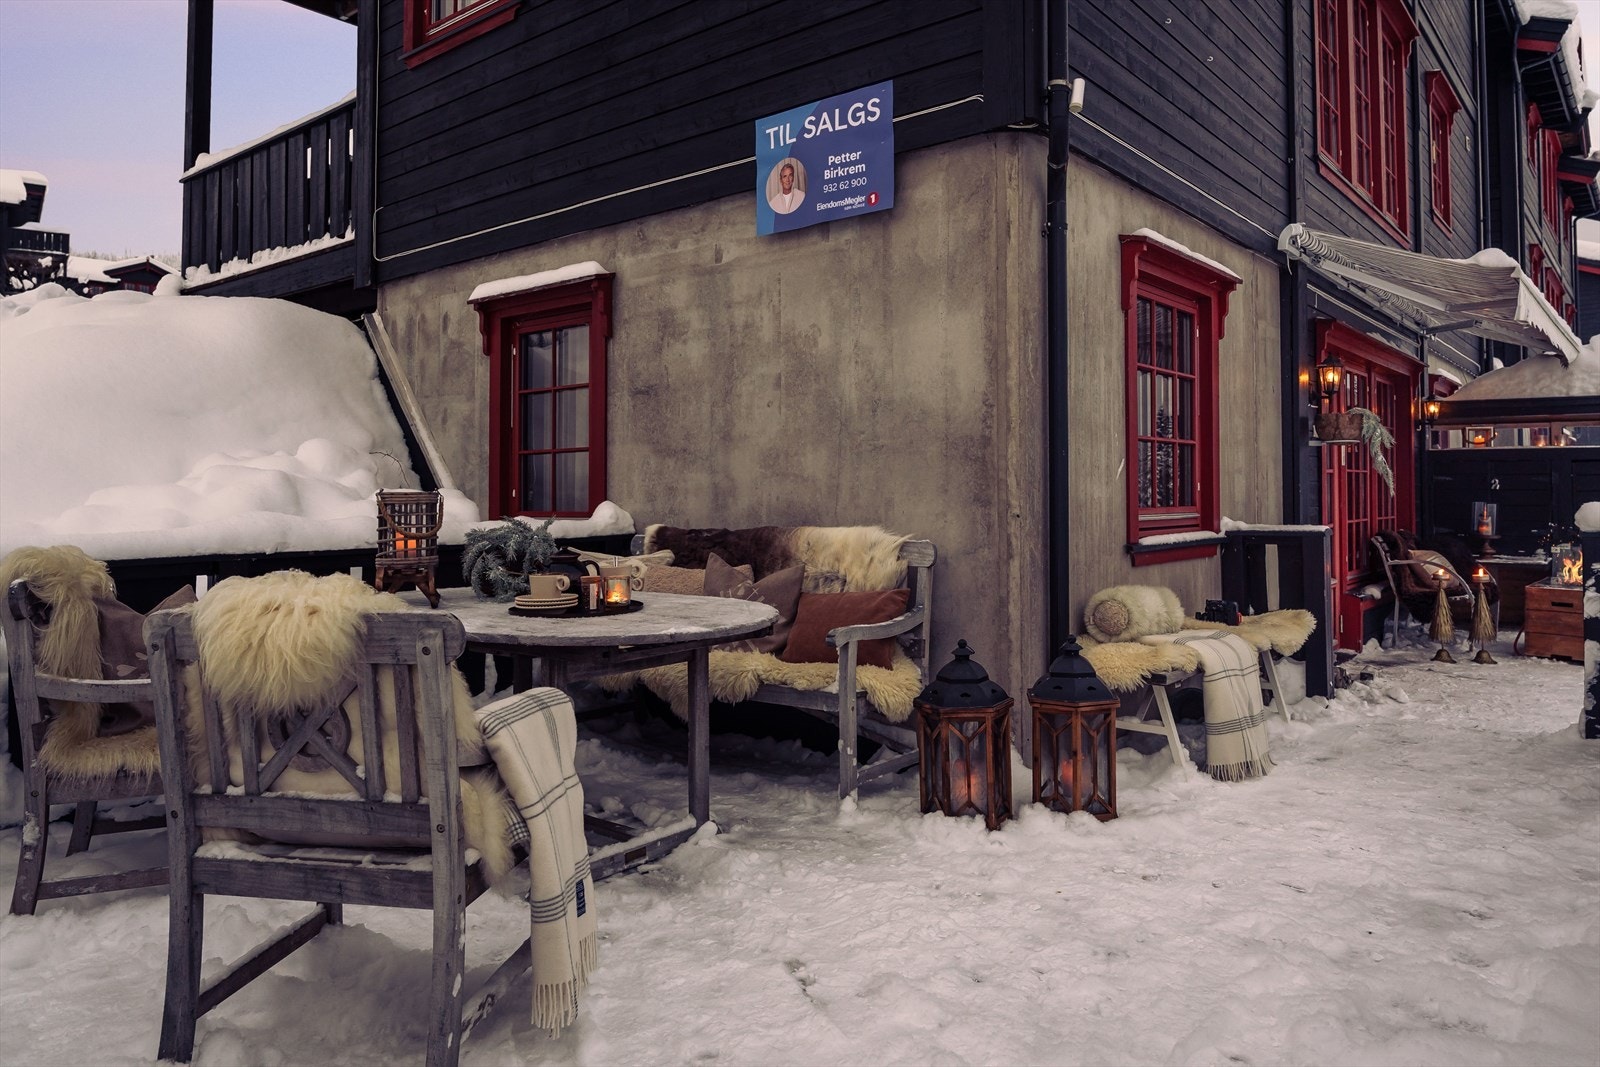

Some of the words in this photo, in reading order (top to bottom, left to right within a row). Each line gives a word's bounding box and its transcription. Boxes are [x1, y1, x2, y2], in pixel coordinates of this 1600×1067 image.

[765, 123, 797, 150] TIL
[803, 97, 881, 139] SALGS
[828, 151, 862, 166] Petter
[824, 163, 866, 180] Birkrem
[823, 183, 838, 193] 932
[839, 181, 850, 190] 62
[851, 177, 867, 188] 900
[816, 195, 866, 211] EiendomsMegler
